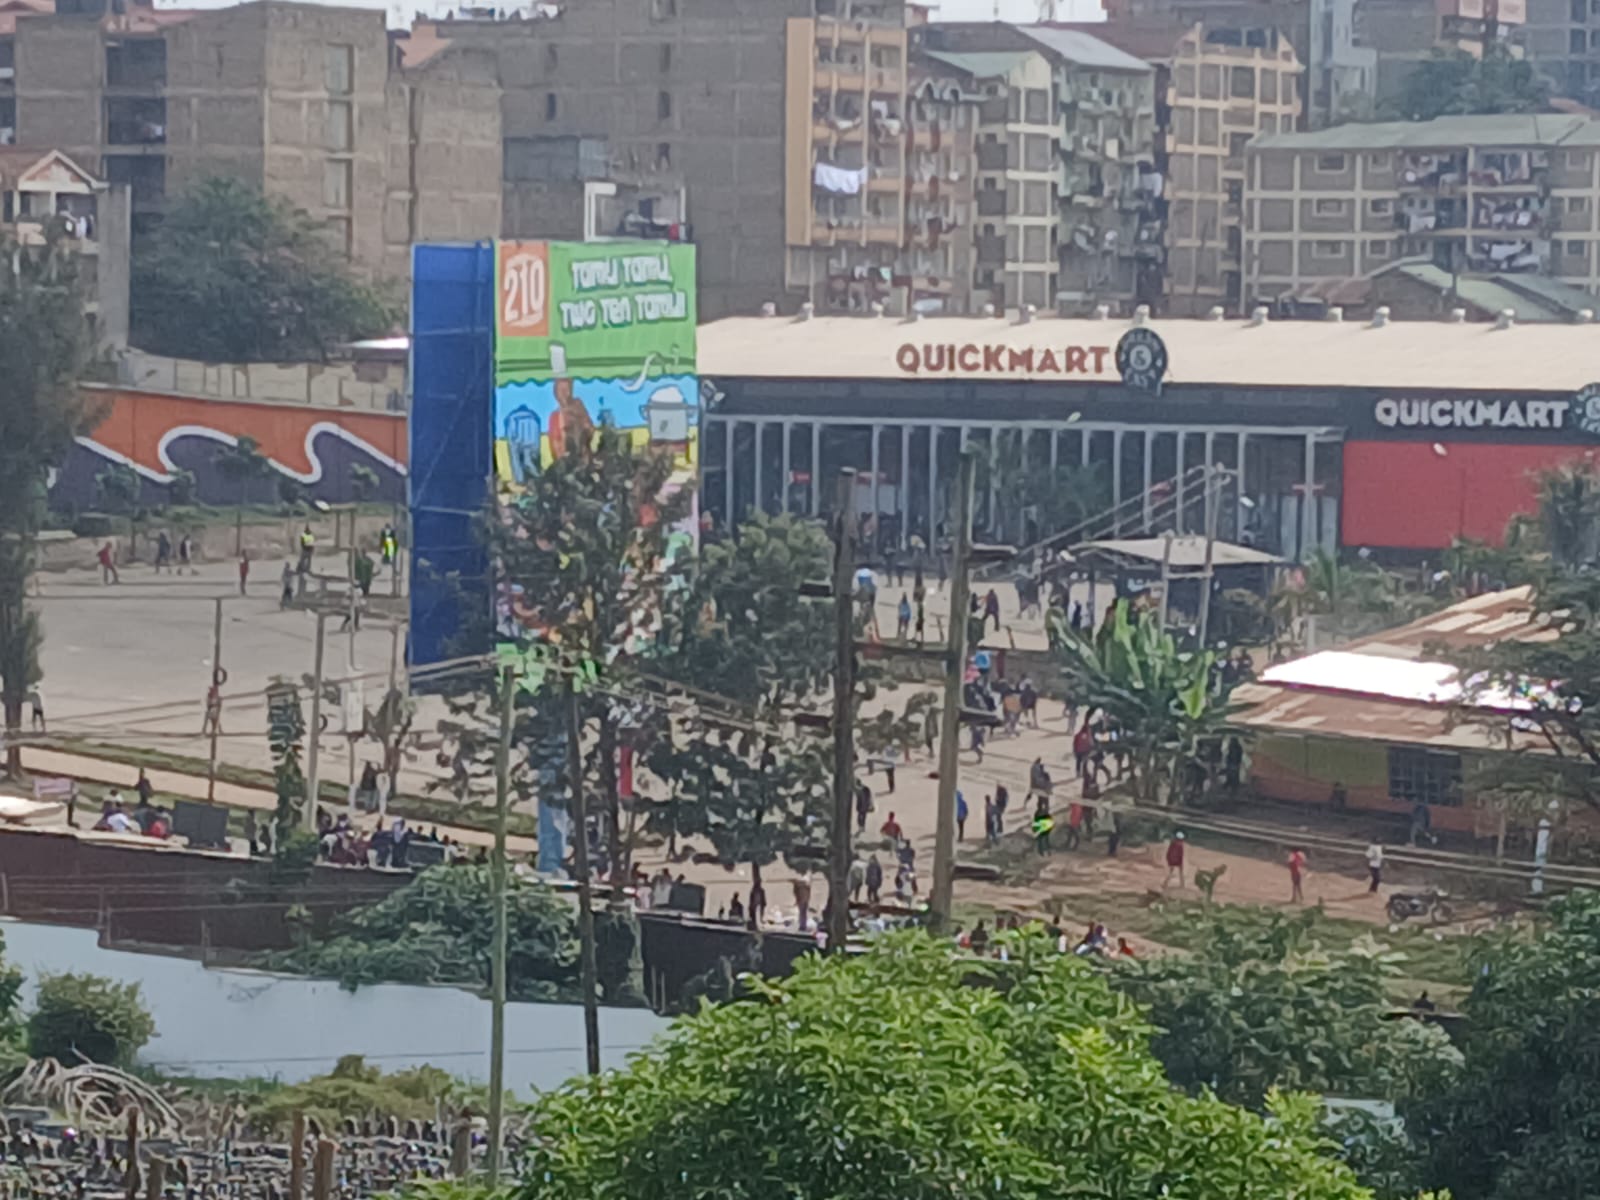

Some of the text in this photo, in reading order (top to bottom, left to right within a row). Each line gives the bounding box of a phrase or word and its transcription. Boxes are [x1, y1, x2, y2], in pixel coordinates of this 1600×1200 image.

[504, 256, 546, 324] 210
[896, 343, 1110, 373] QUICKMART
[1374, 398, 1570, 428] QUICKMART
